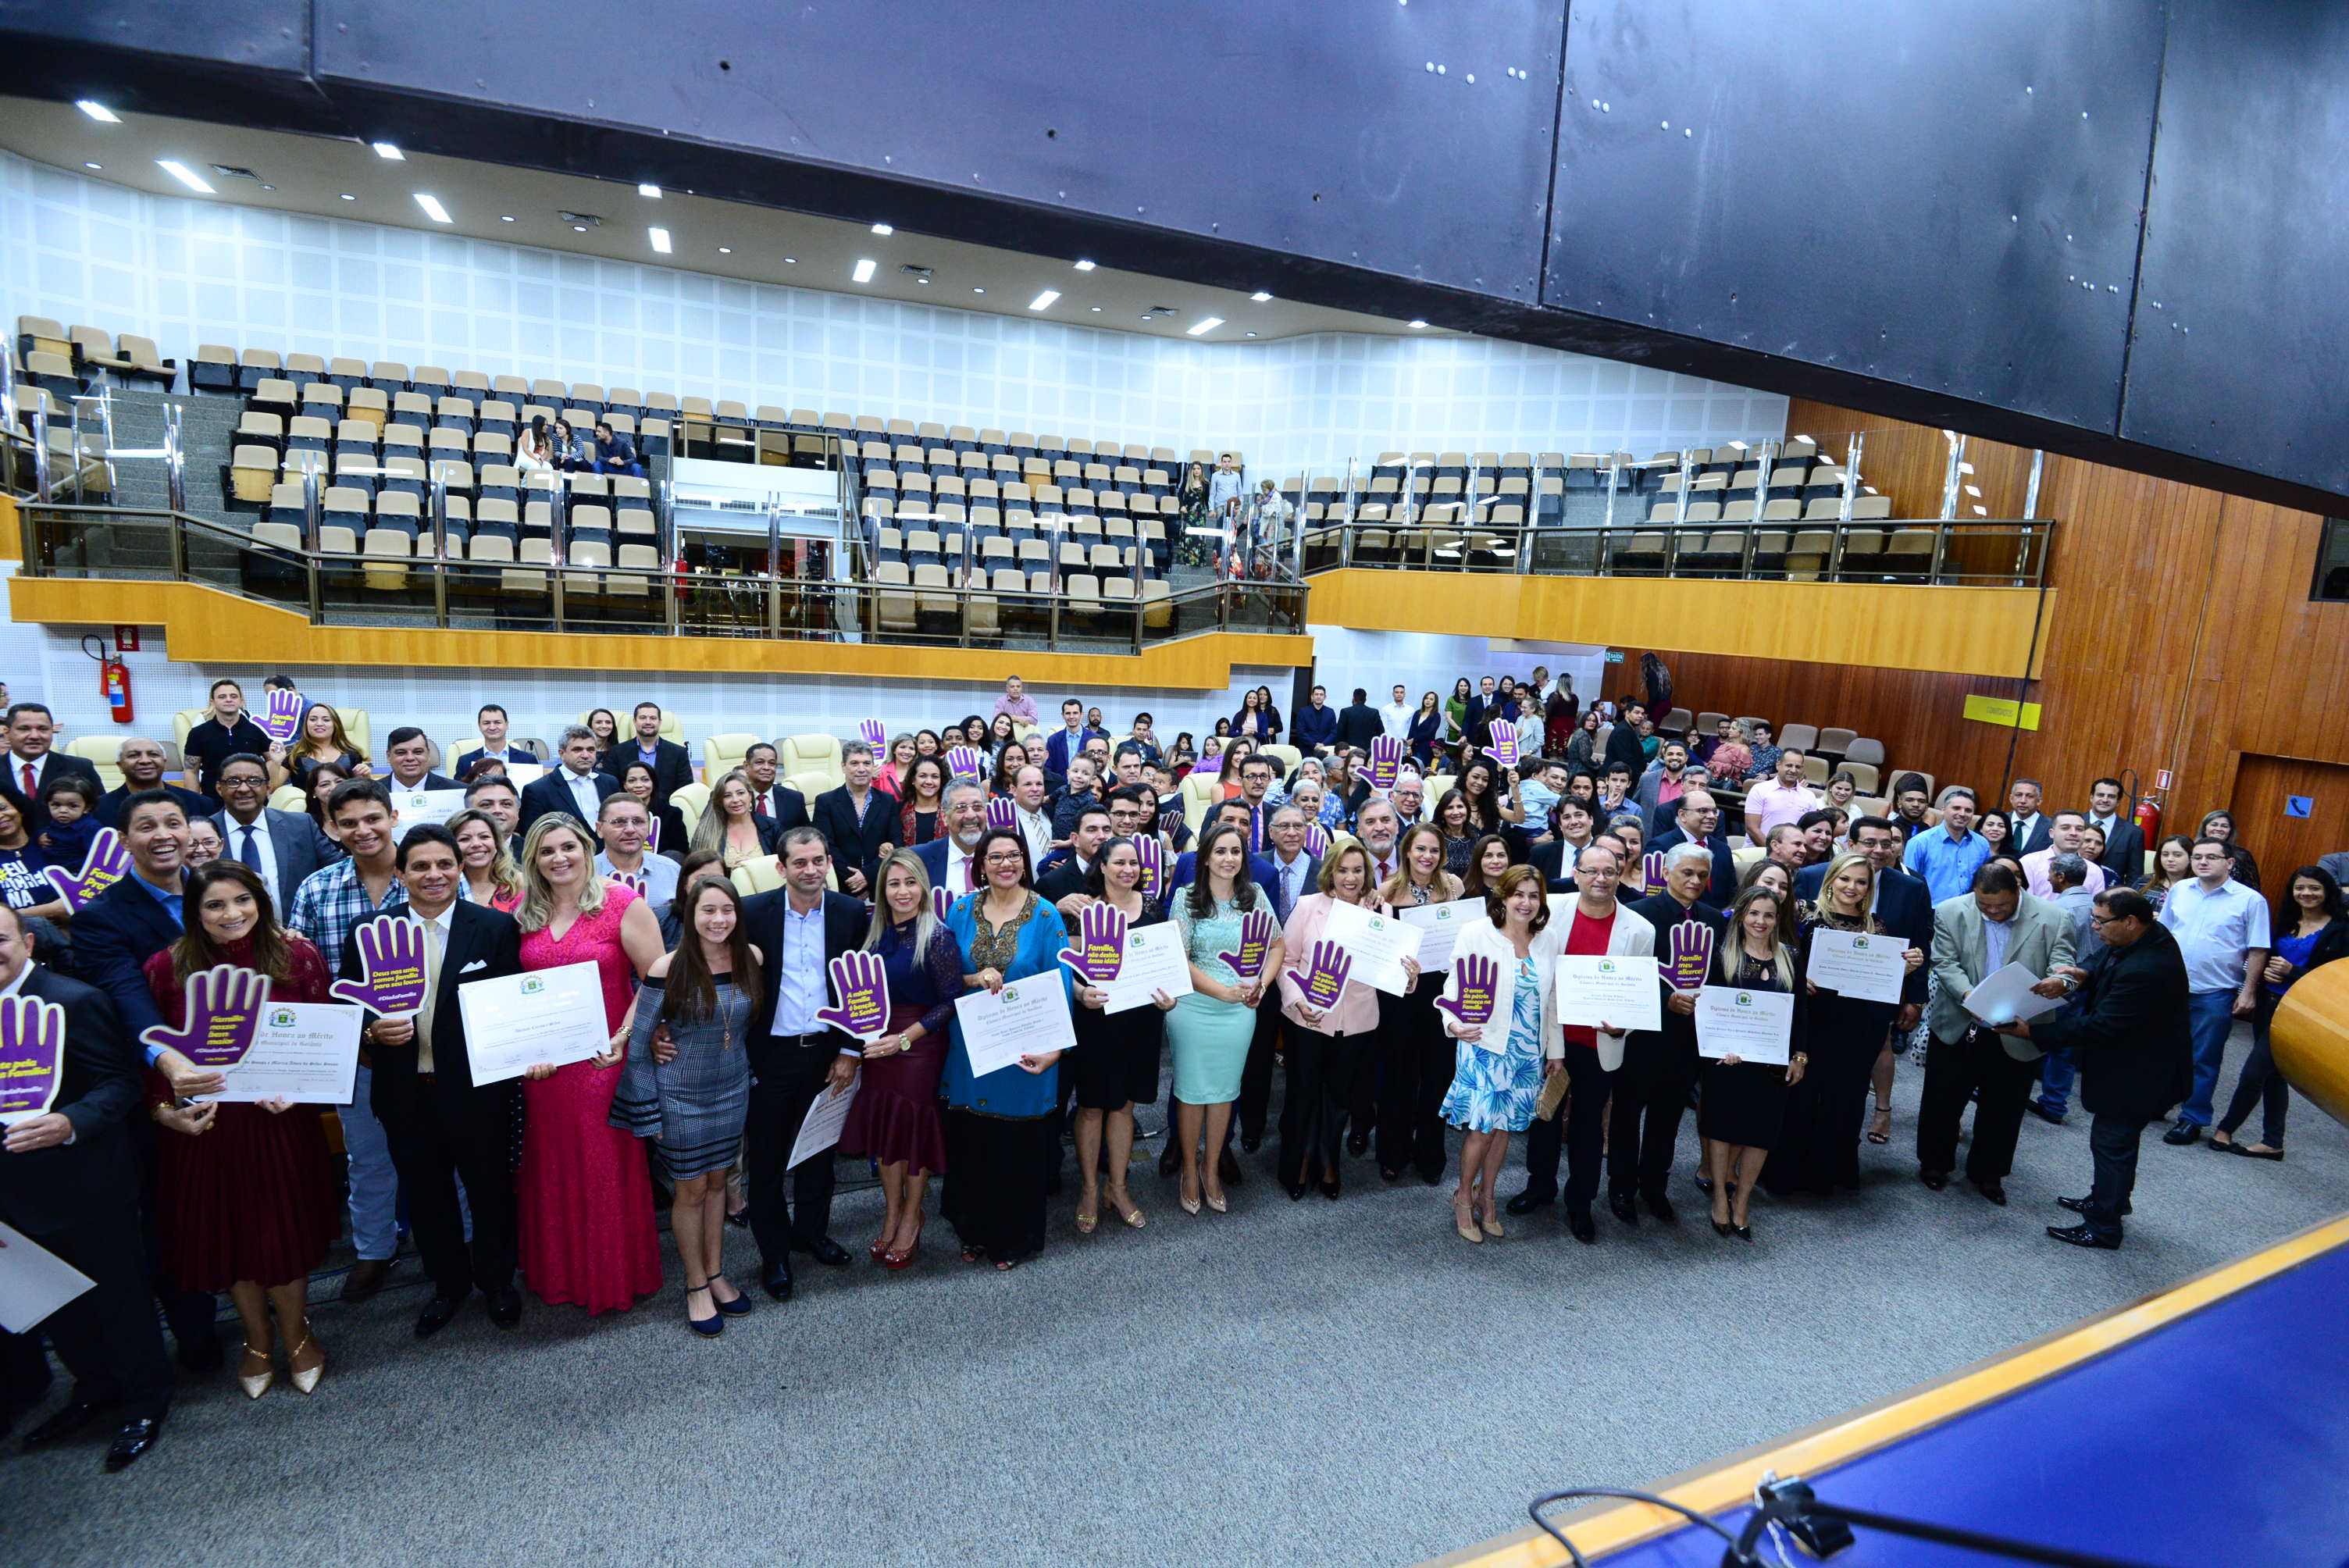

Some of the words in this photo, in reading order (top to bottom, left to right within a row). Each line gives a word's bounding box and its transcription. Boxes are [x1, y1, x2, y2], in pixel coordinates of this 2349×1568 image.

[1088, 944, 1115, 953] Família,
[395, 972, 419, 982] família
[1320, 978, 1338, 986] pátria
[1311, 985, 1329, 995] Família
[848, 996, 871, 1005] Família
[859, 1007, 881, 1016] Senhor
[7, 1066, 53, 1078] Família!
